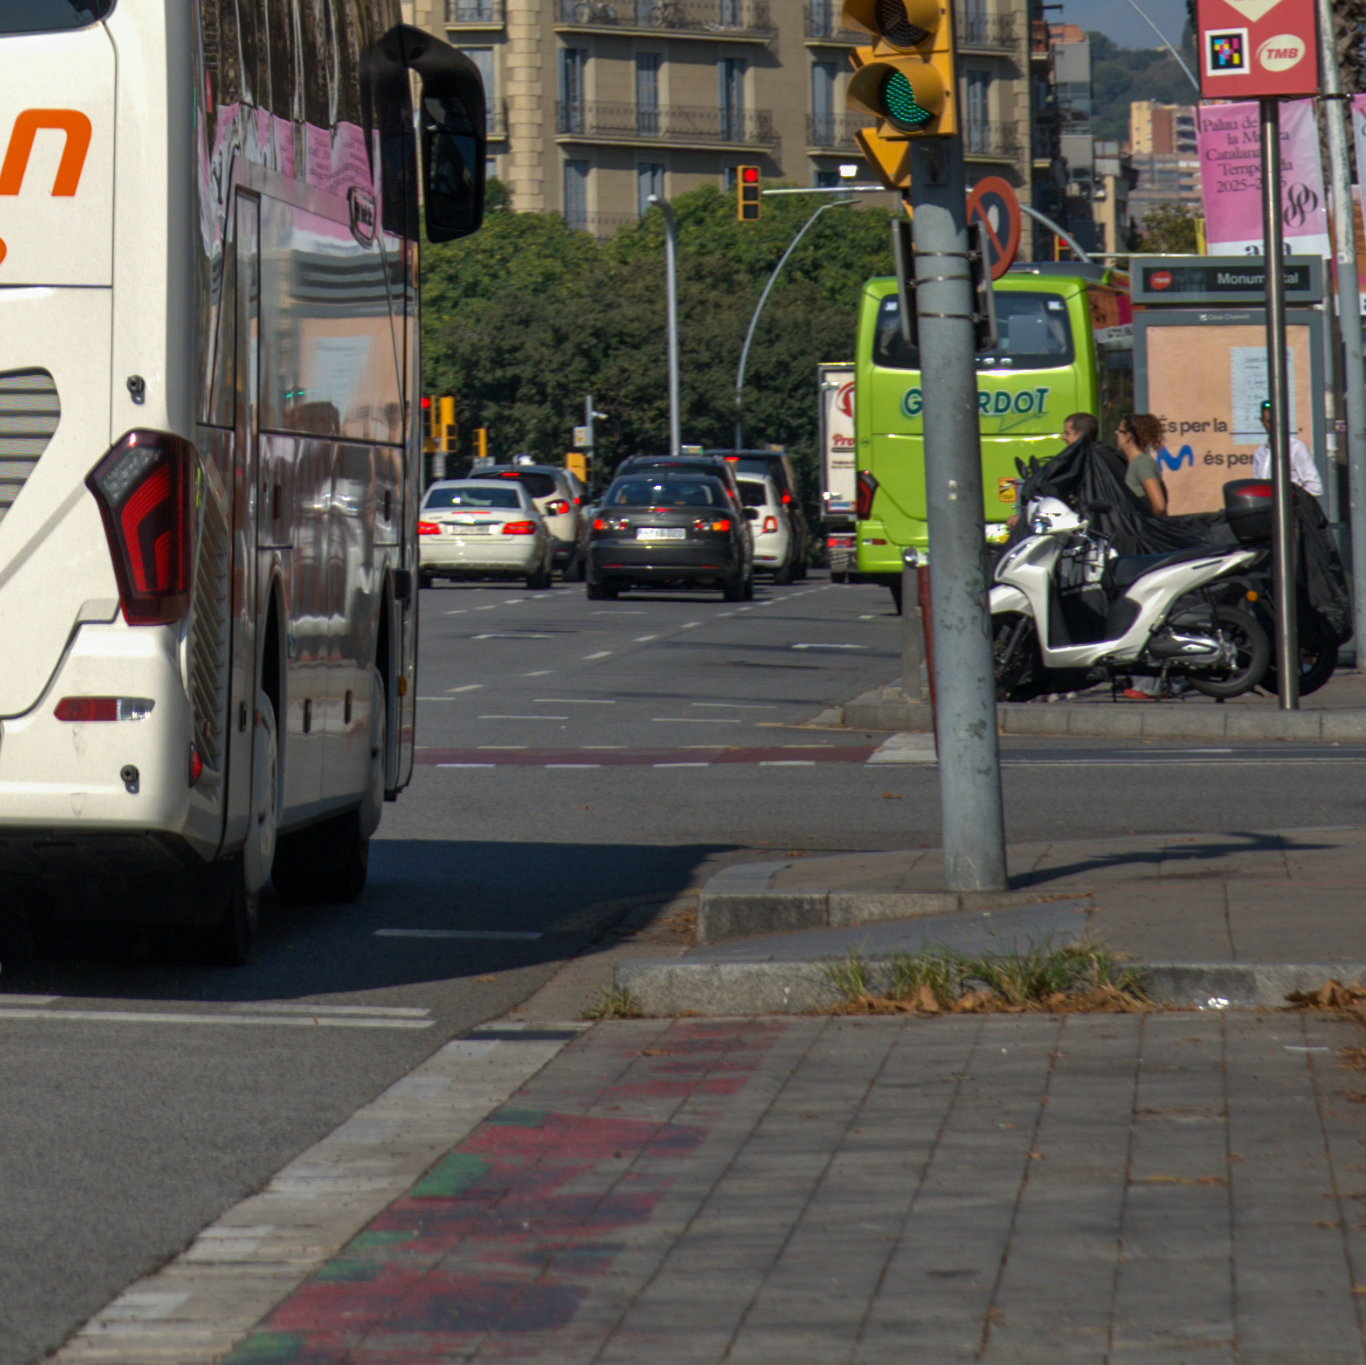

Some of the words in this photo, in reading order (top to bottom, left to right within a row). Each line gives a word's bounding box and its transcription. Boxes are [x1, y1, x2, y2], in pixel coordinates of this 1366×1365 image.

[1266, 47, 1299, 60] TMB
[1202, 119, 1238, 132] Palau
[1180, 420, 1211, 437] per
[1213, 417, 1228, 433] la
[1203, 450, 1225, 466] és
